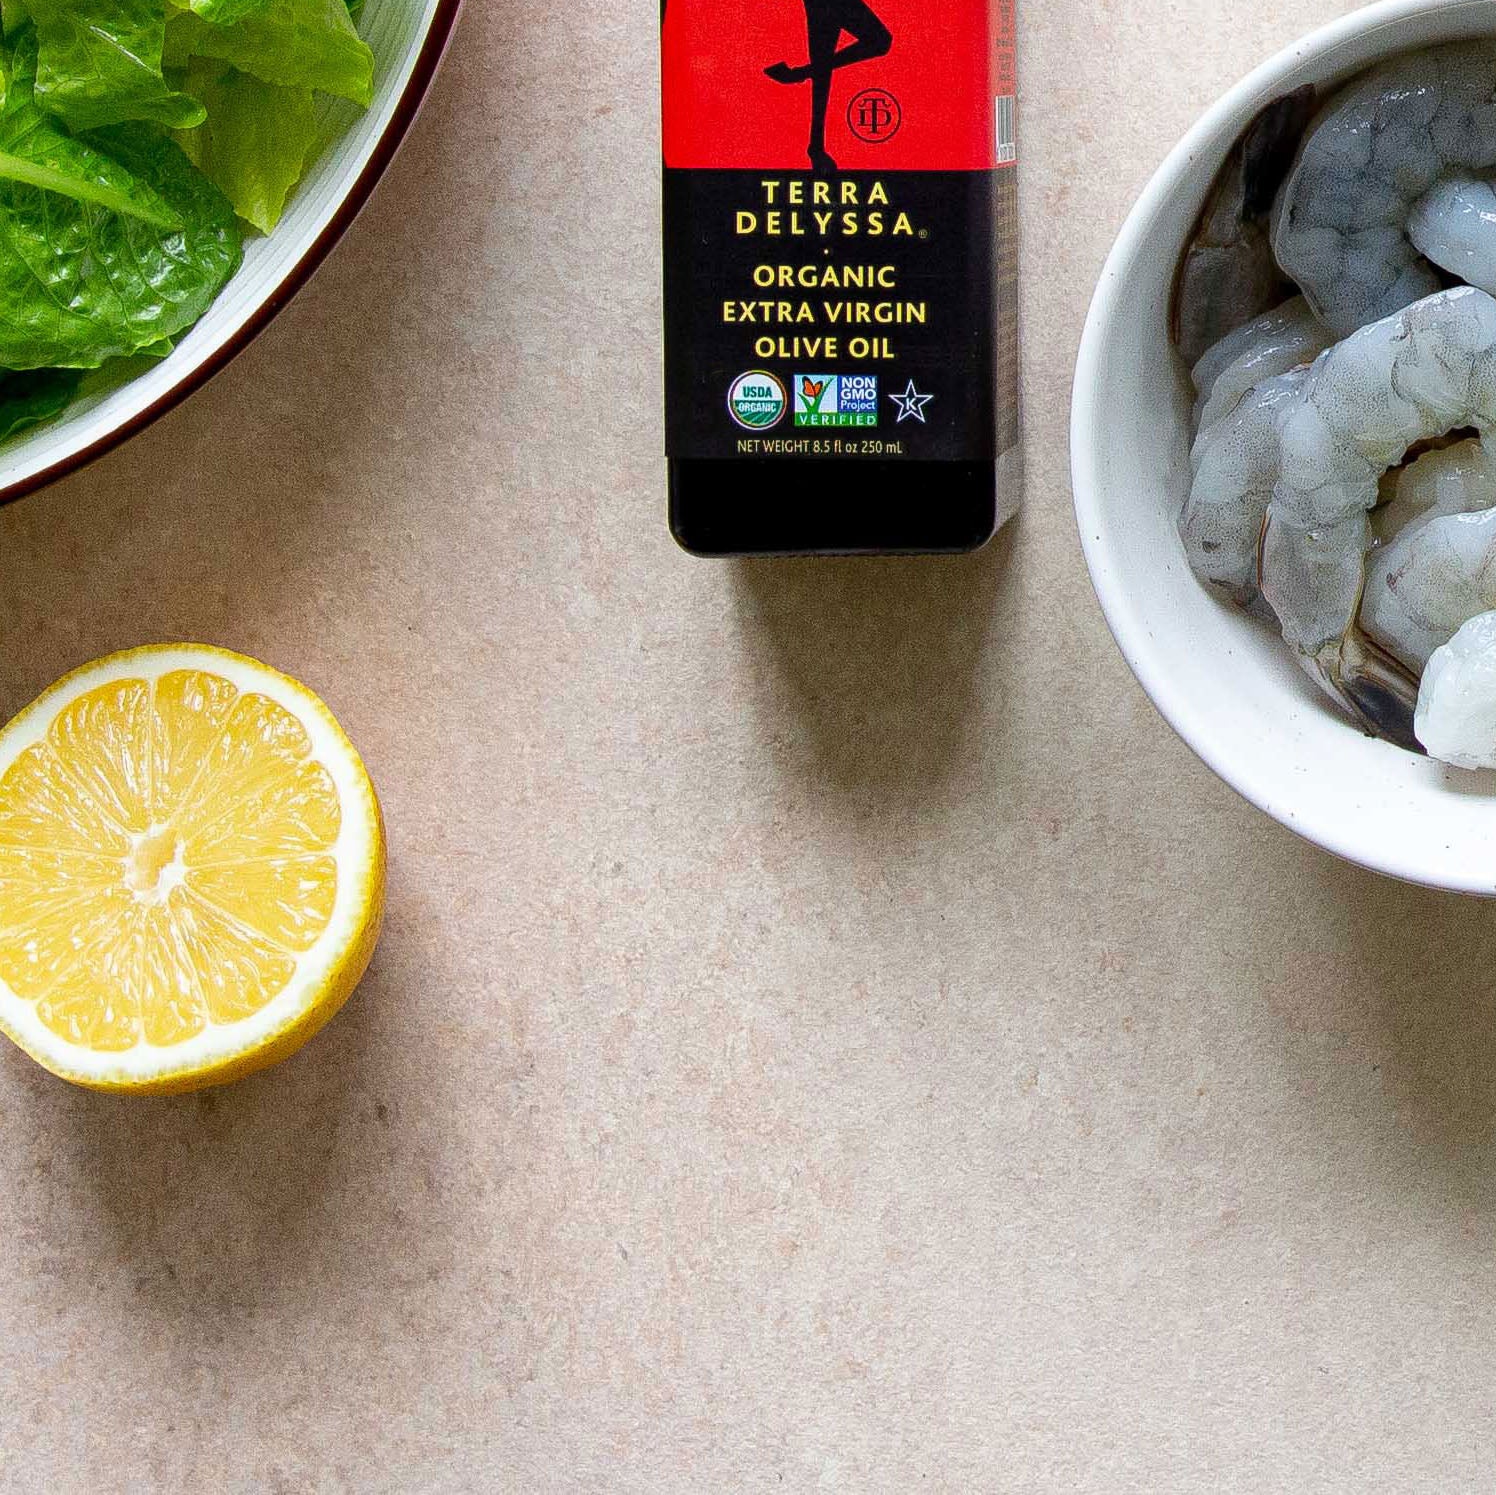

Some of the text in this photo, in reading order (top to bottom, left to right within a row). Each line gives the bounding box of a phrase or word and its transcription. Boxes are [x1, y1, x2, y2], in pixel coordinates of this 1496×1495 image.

[761, 181, 890, 204] TERRA
[752, 264, 896, 288] ORGANIC
[722, 301, 926, 323] EXTRA VIRGIN
[754, 337, 895, 359] OLIVE OIL
[841, 377, 876, 389] NON
[742, 386, 773, 398] USDA
[840, 388, 877, 401] GMO
[737, 402, 777, 413] ORGANIC
[840, 400, 876, 412] Project
[905, 397, 917, 411] K
[799, 414, 877, 425] VERIFIED
[737, 440, 903, 453] NET WEIGHT 8.5 fl oz 250 mL
